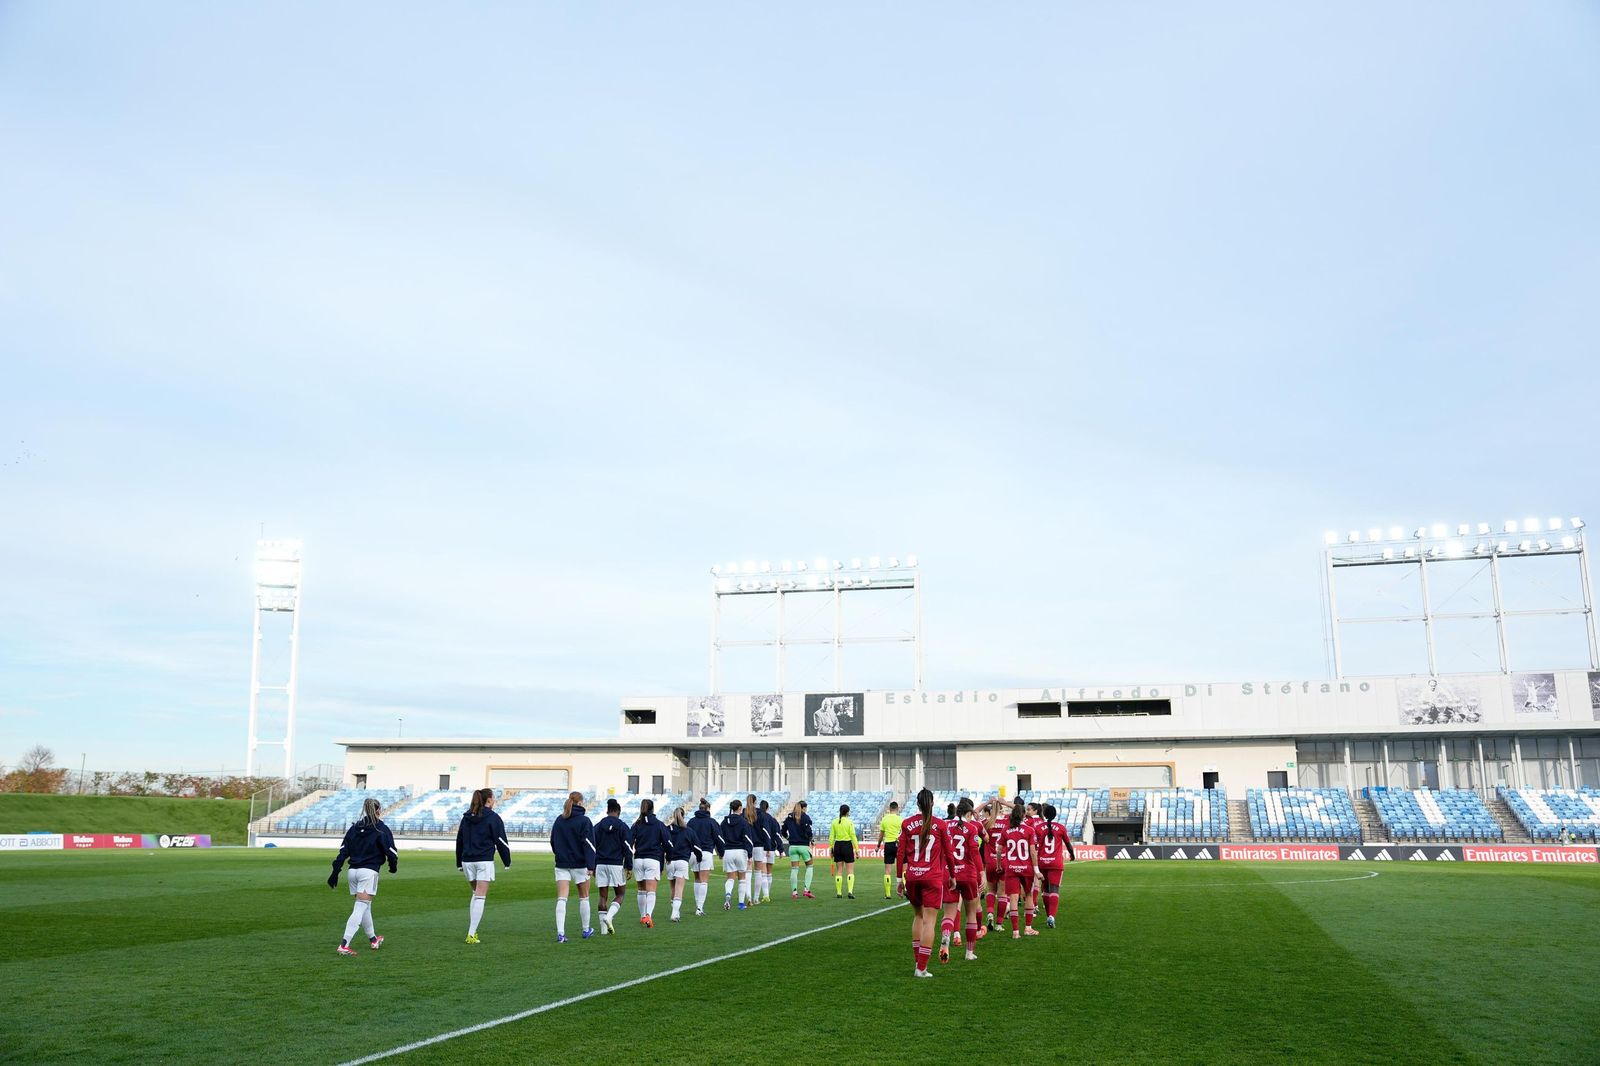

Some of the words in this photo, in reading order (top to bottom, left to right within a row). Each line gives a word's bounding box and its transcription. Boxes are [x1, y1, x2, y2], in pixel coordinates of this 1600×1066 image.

[885, 691, 998, 704] Estadio
[1041, 686, 1160, 701] Alfredo
[1185, 684, 1213, 697] Di
[1241, 681, 1370, 695] Stéfano
[31, 838, 60, 847] ABBOTT
[911, 834, 936, 862] 17
[953, 834, 966, 860] 3
[1006, 838, 1029, 861] 20
[1044, 834, 1055, 854] 9
[1222, 848, 1278, 860] Emirates
[1280, 848, 1338, 860] Emirates
[1465, 849, 1529, 862] Emirates
[1531, 849, 1597, 863] Emirates
